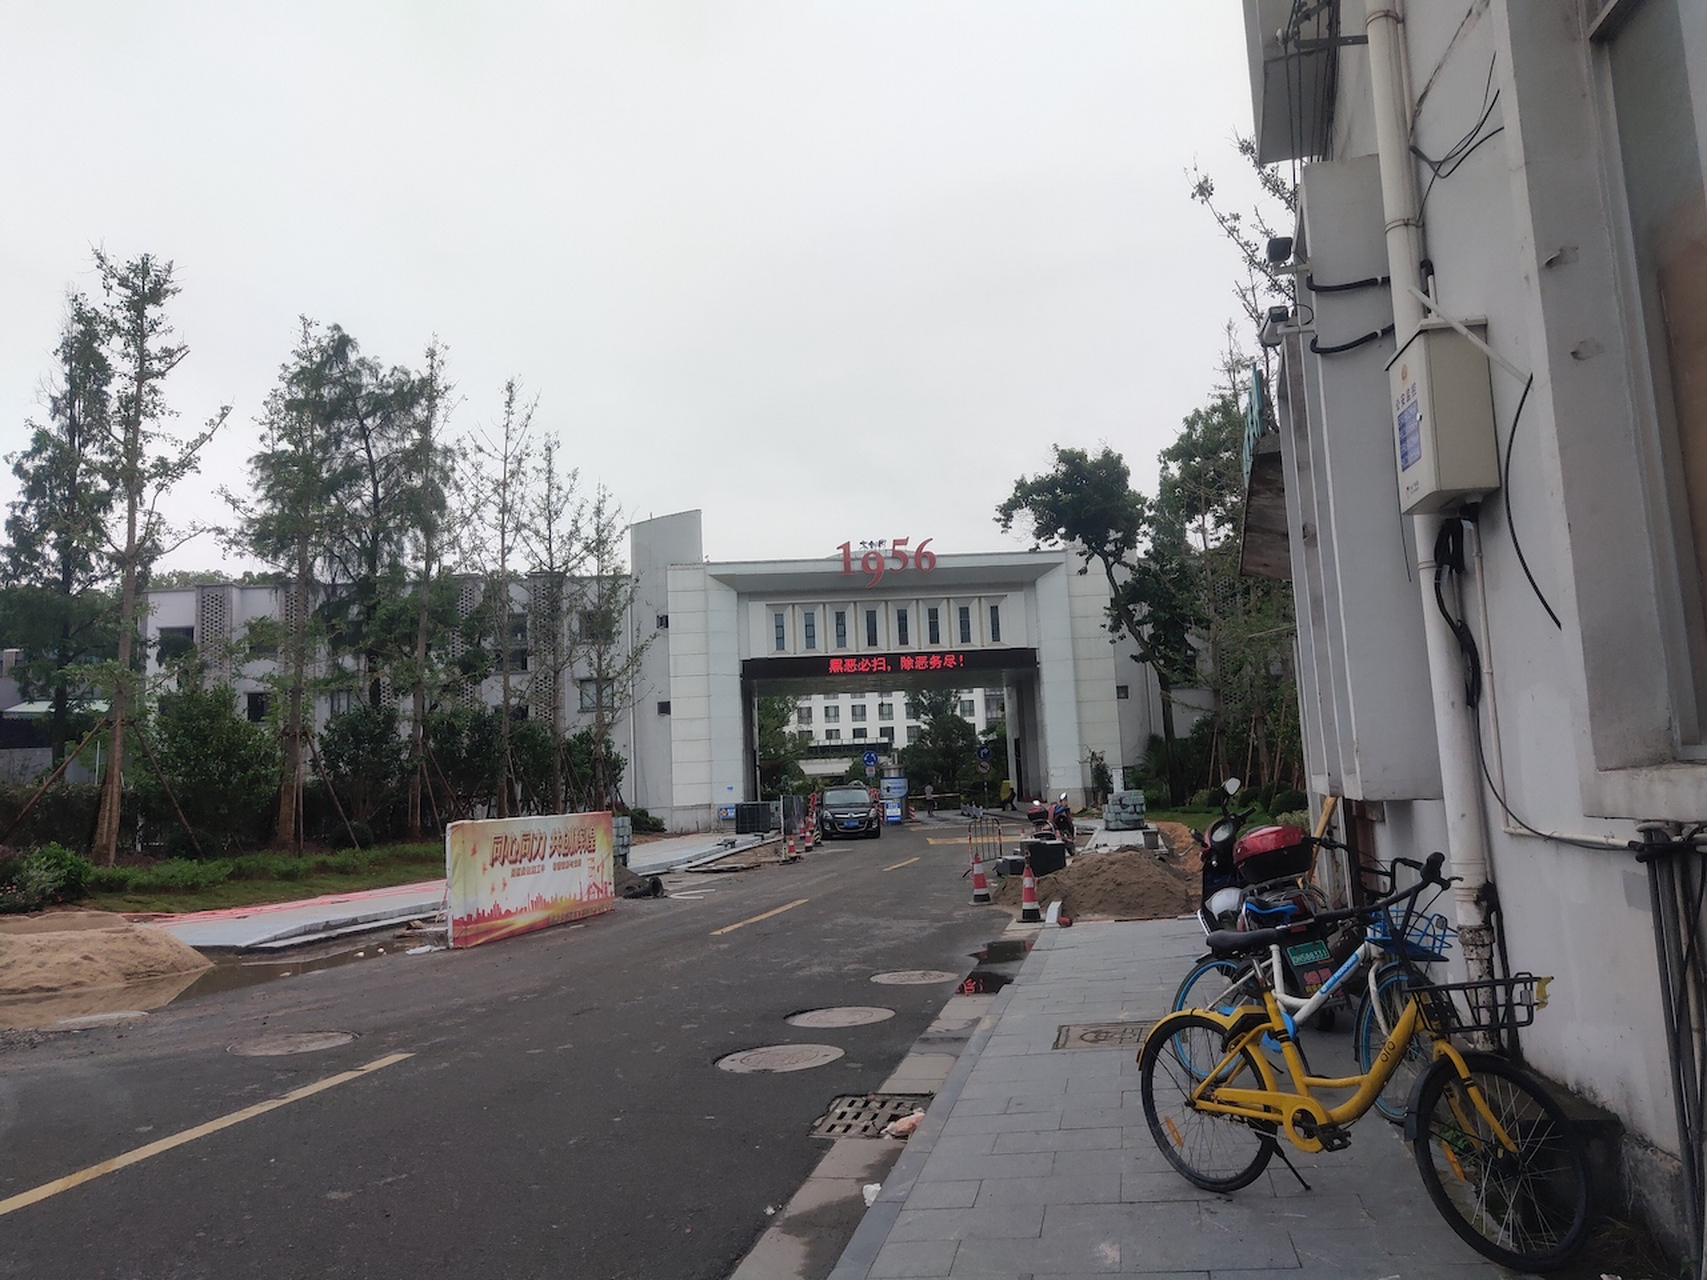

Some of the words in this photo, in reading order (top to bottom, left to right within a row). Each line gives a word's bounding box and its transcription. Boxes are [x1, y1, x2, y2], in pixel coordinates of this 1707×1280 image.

[836, 536, 937, 588] 1956
[490, 830, 546, 867] 同心同力
[549, 826, 596, 857] 共创辉煌
